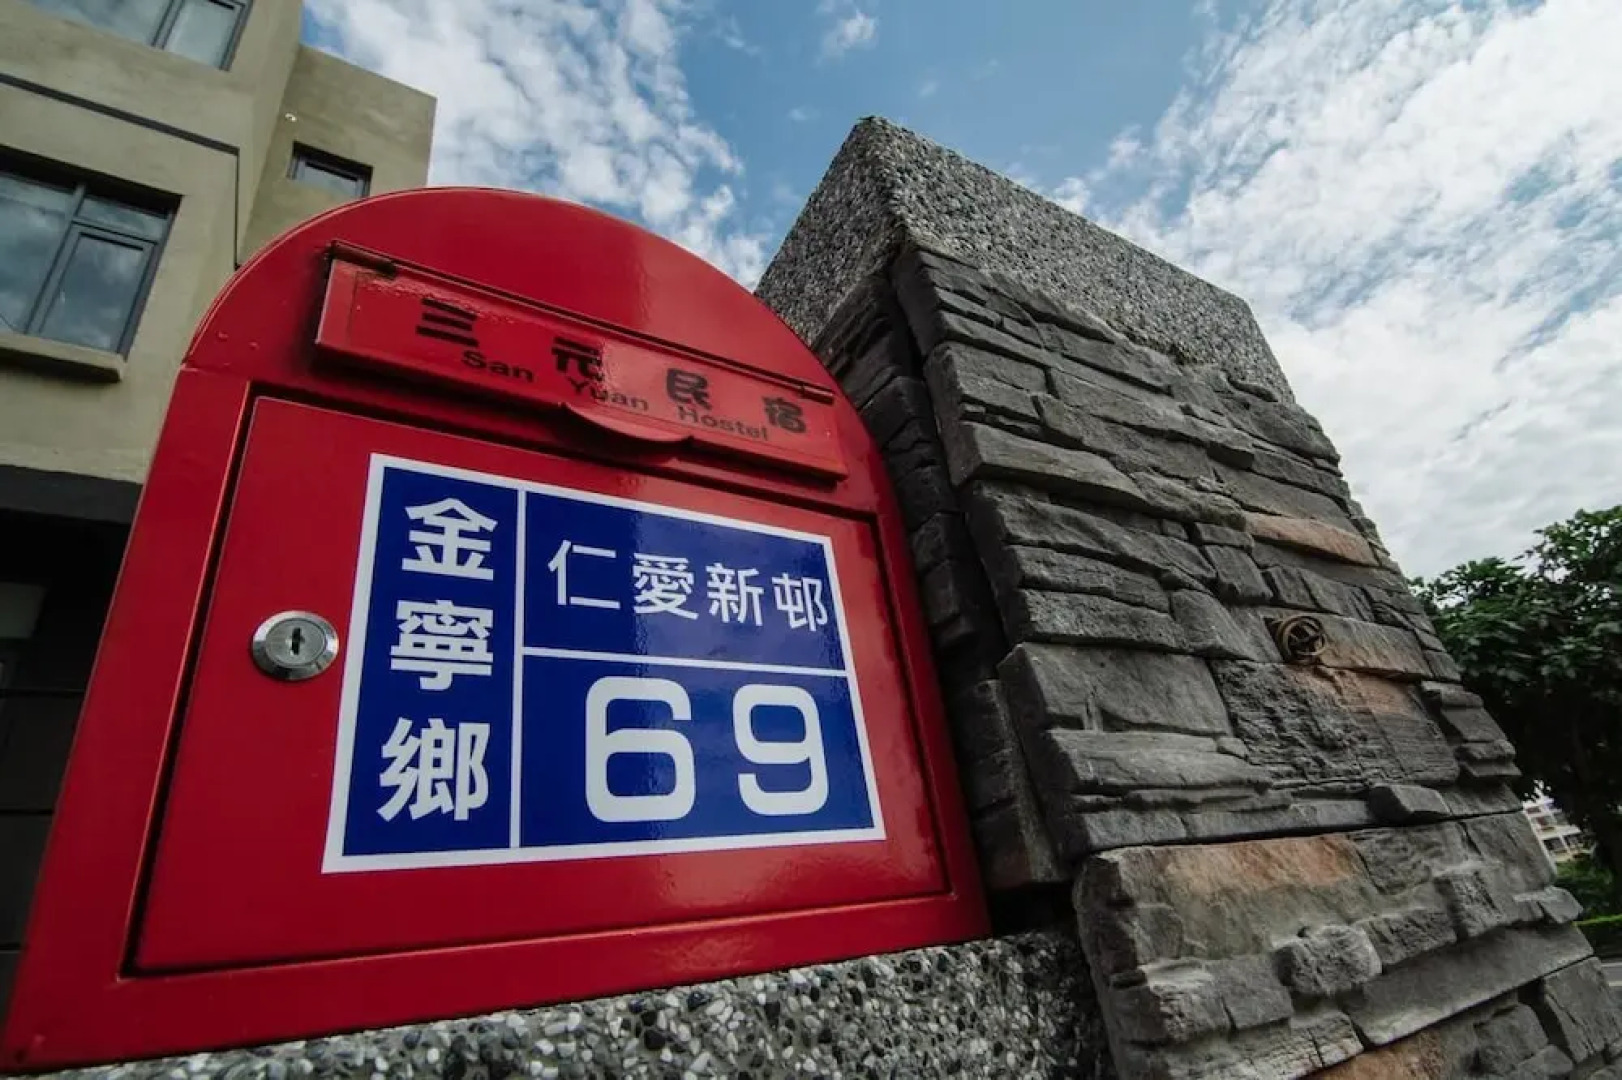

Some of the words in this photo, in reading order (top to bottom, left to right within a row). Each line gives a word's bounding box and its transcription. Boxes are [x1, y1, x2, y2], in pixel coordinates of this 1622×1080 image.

[416, 297, 806, 433] 三元民宿
[461, 349, 534, 383] San
[568, 377, 648, 411] Yuan
[677, 405, 769, 441] Hostel
[547, 539, 829, 632] 仁愛新邨
[377, 498, 497, 822] 金寧鄉
[585, 676, 829, 823] 69
